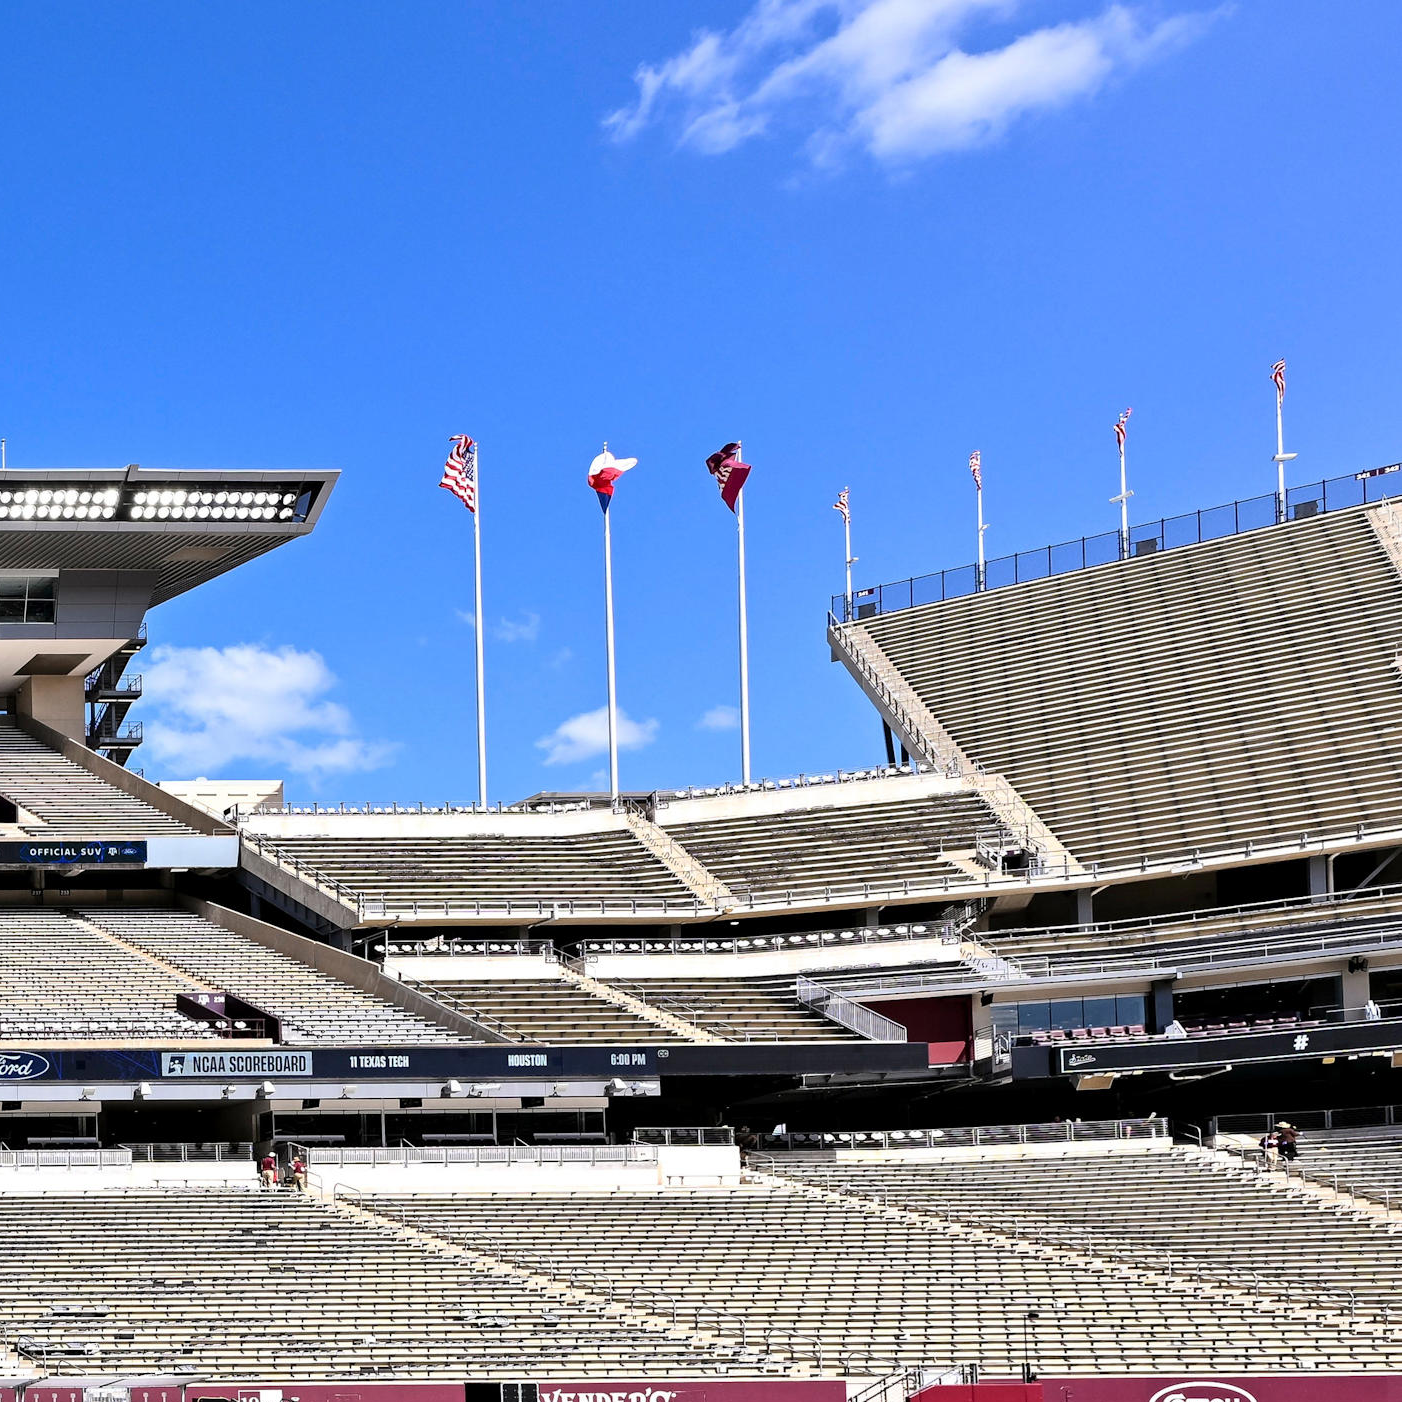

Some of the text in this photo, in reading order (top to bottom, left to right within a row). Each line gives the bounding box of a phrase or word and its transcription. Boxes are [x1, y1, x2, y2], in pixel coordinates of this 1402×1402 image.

[30, 848, 77, 857] OFFICIAL
[81, 848, 101, 857] SUV
[193, 1056, 306, 1073] NCAA SCOREBOARD
[350, 1055, 409, 1068] 11 TEXAS TECH
[508, 1054, 547, 1067] HOUSTON
[611, 1054, 646, 1066] 6:00 PM
